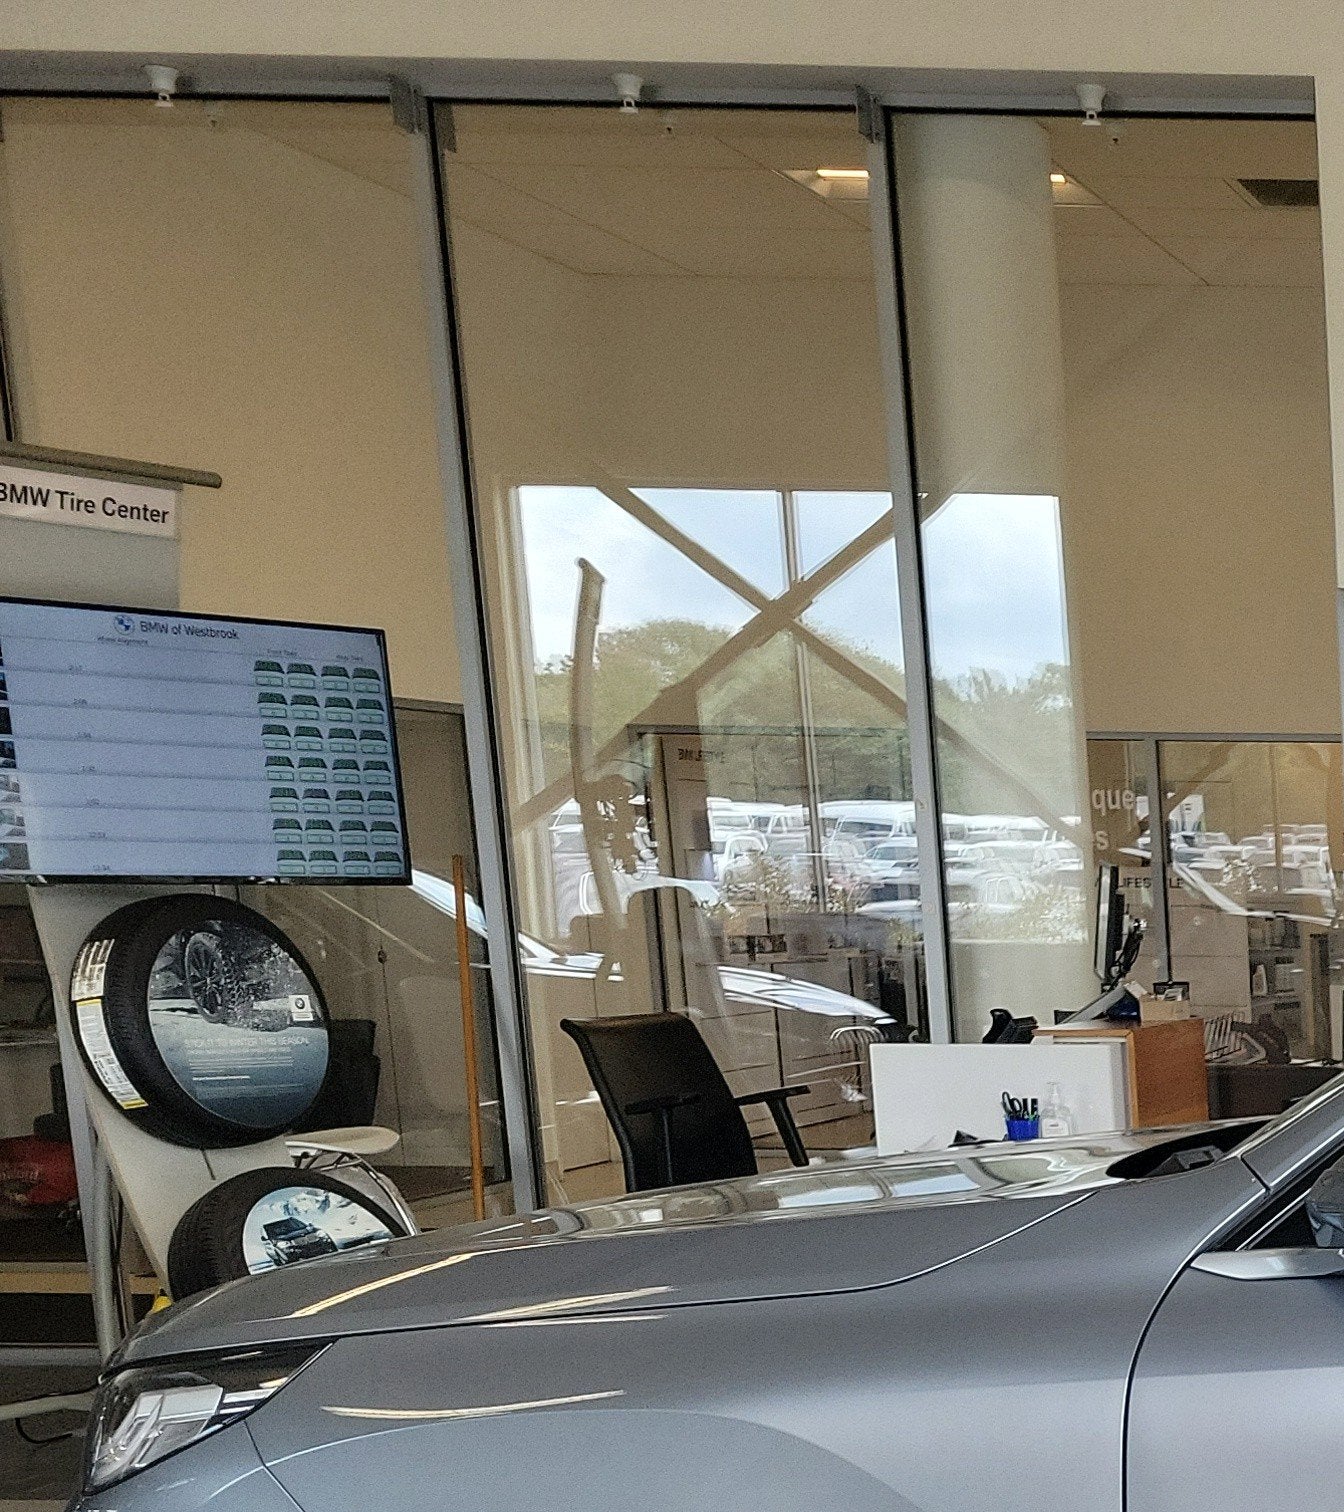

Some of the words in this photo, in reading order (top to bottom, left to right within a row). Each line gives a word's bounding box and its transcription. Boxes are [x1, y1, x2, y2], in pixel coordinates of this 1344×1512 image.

[0, 482, 51, 508] BMW
[55, 489, 96, 514] Tire
[101, 496, 170, 524] Center
[140, 621, 169, 635] BMW
[171, 624, 181, 635] of
[183, 624, 240, 640] Westbrook
